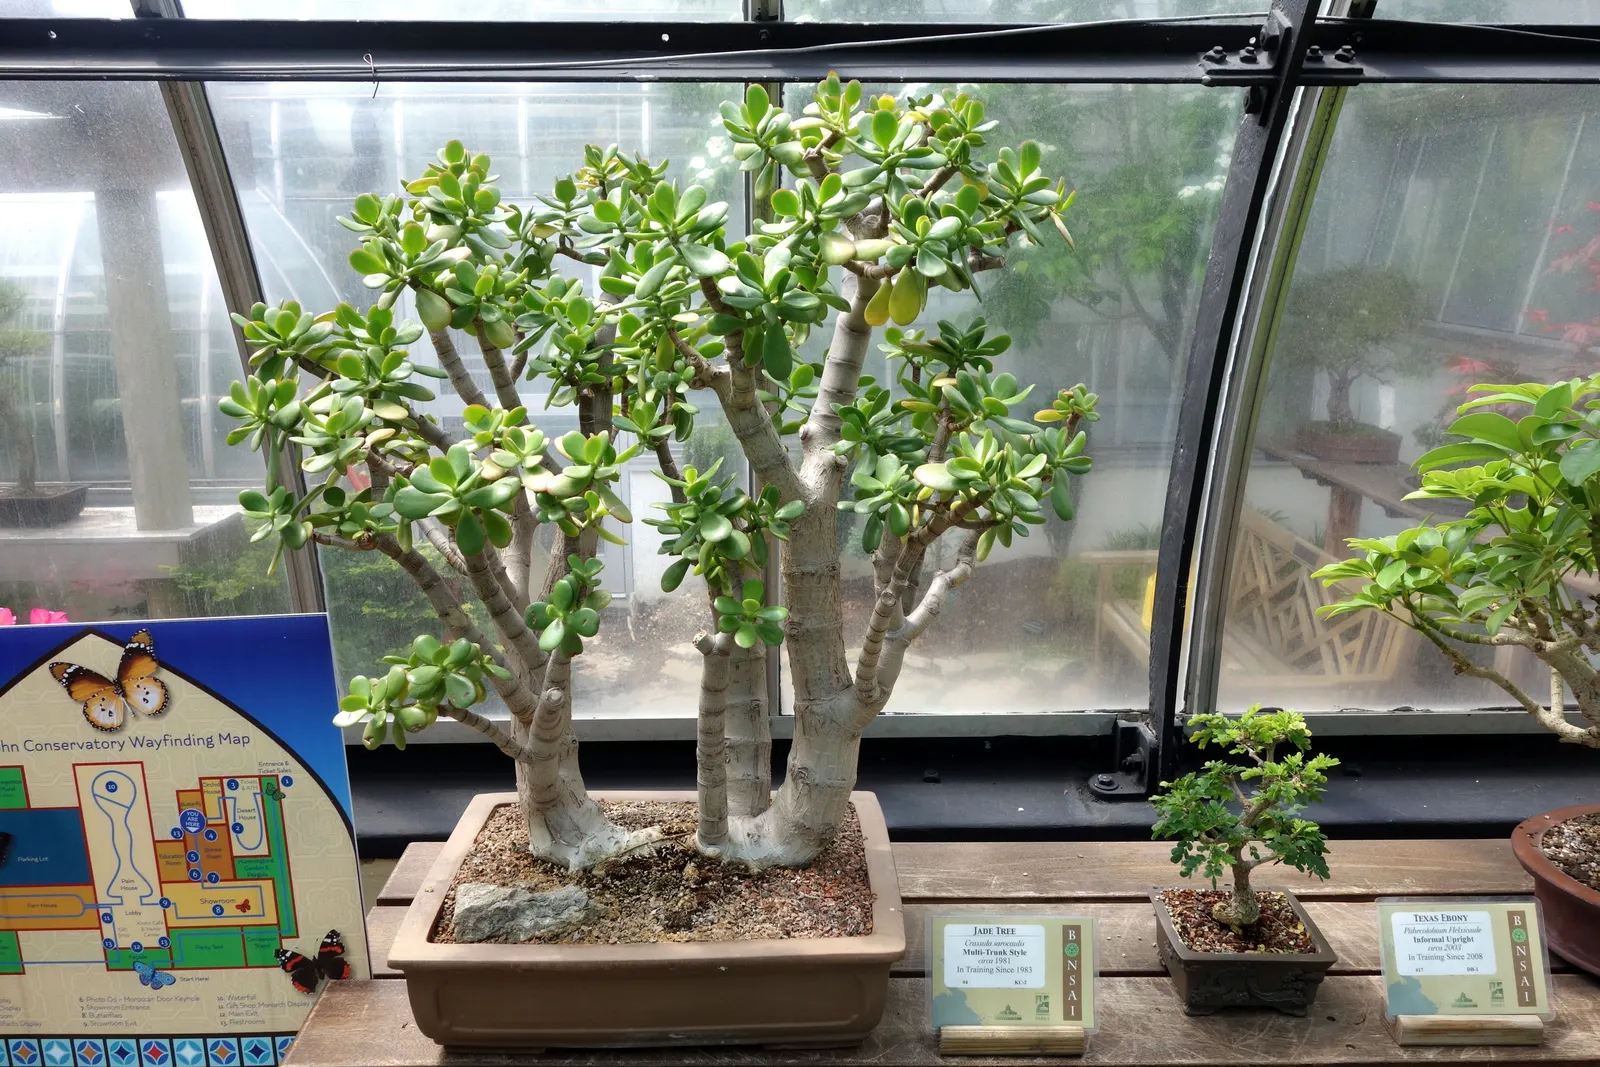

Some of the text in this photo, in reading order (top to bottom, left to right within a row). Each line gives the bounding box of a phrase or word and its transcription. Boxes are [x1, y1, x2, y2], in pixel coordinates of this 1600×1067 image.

[0, 732, 250, 752] hn Conservatory Wayfinding Map
[1414, 914, 1468, 922] TEXAS EBONY
[973, 926, 1016, 936] JADE TREE
[1009, 949, 1027, 957] Style
[1417, 954, 1445, 962] Training
[965, 966, 994, 975] Training
